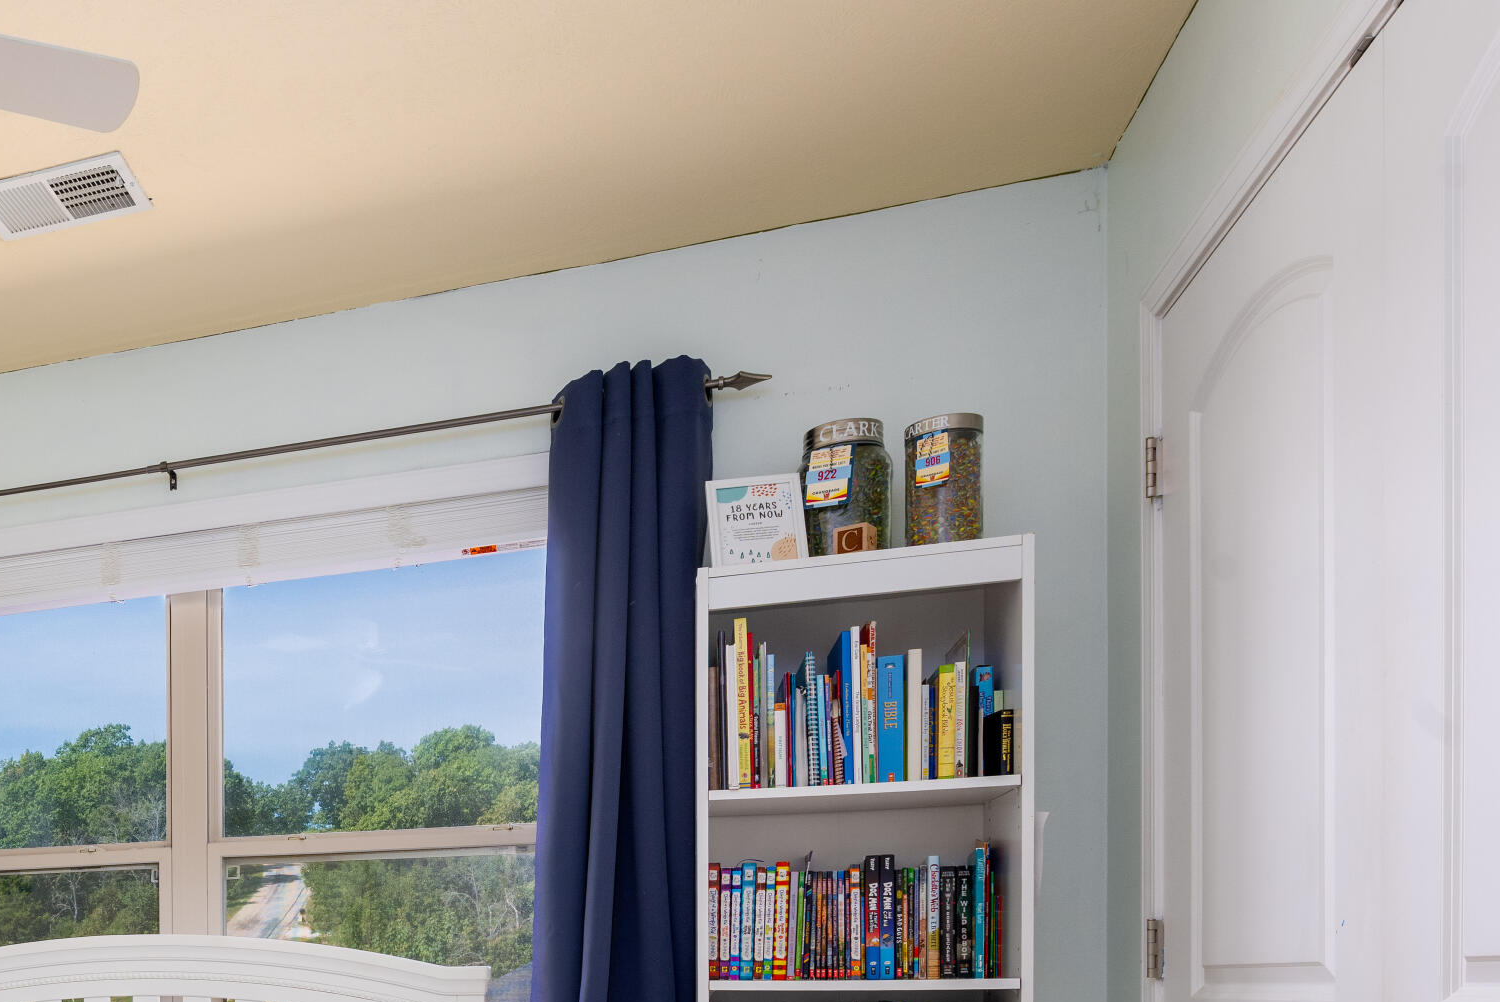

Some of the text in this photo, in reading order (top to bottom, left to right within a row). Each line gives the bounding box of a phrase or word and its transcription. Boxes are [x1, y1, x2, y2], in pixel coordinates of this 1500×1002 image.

[820, 421, 880, 442] CLARK
[926, 456, 940, 467] 906
[818, 469, 837, 481] 922
[726, 510, 783, 522] FROM NOW
[730, 502, 777, 513] 18 YEARS
[842, 530, 858, 551] C
[883, 701, 897, 730] BIBLE
[868, 883, 878, 911] DOG MAN
[883, 882, 892, 910] DOG MAN
[930, 864, 939, 912] Charlotte's Web
